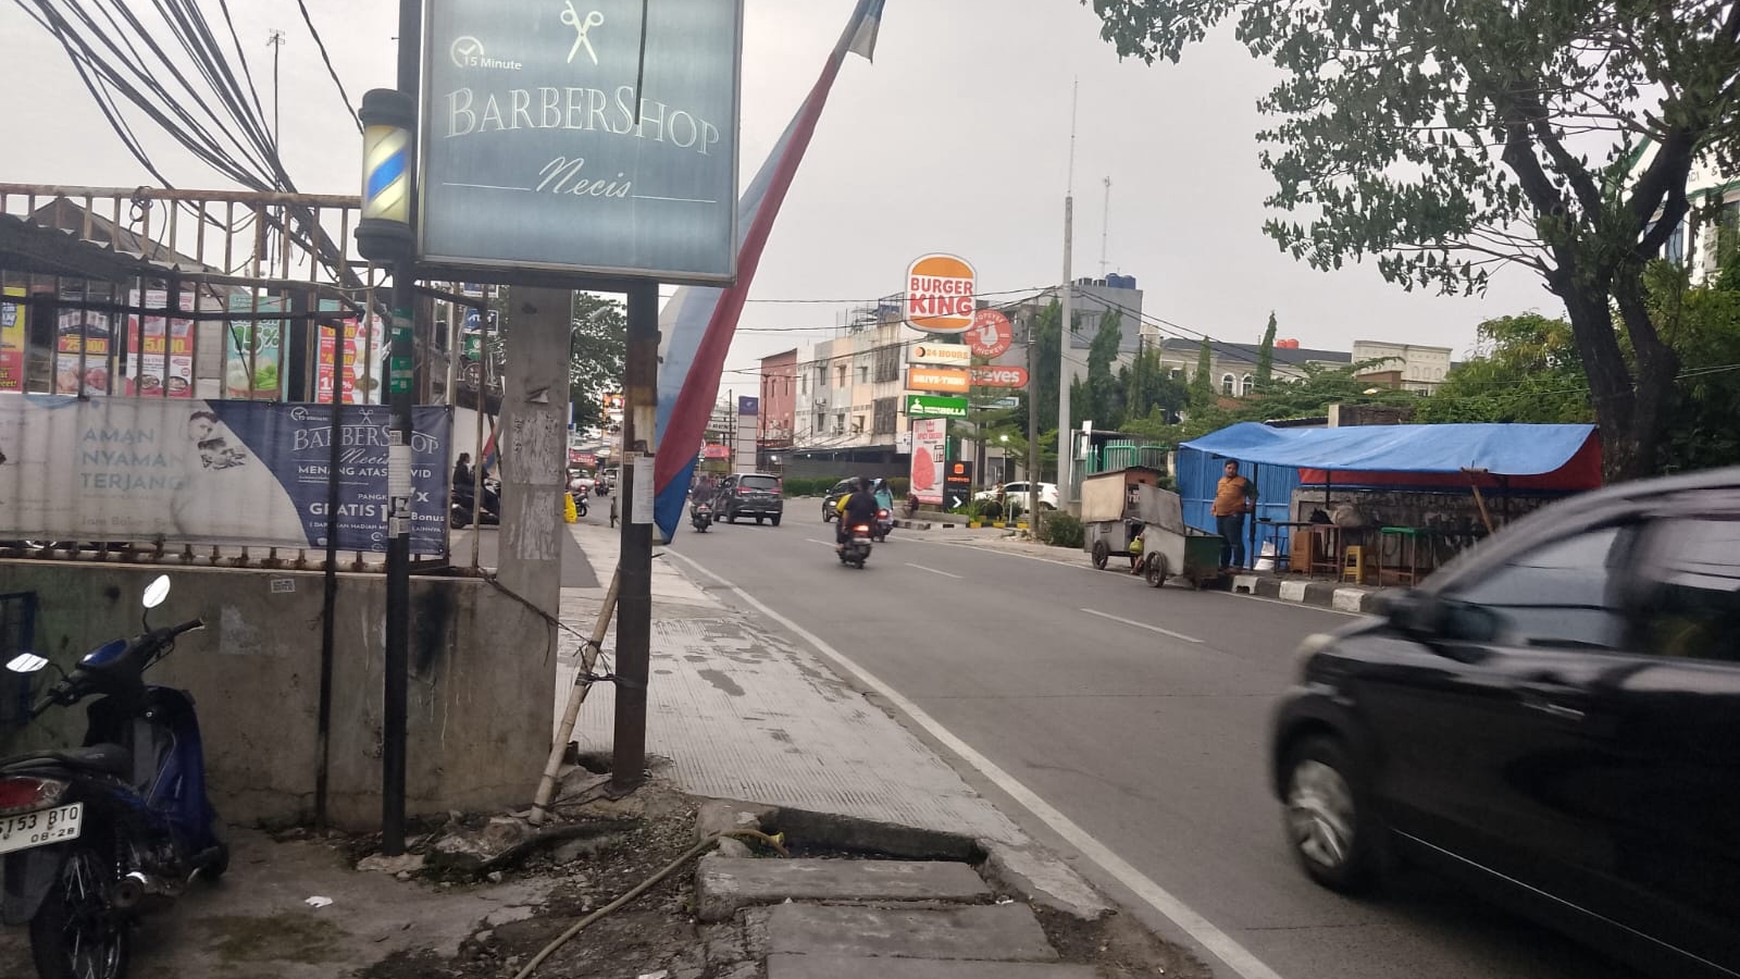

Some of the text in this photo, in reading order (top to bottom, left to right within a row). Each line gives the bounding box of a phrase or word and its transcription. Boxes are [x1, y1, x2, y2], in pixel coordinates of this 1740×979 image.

[462, 56, 522, 71] 15 Minute
[536, 156, 633, 198] Necis
[911, 278, 972, 297] BURGER
[910, 294, 972, 316] KING
[938, 350, 968, 359] HOURS
[972, 343, 1004, 356] CHICKEN
[84, 428, 154, 444] AMAN
[359, 467, 388, 477] ATAS
[411, 511, 445, 521] Bonus
